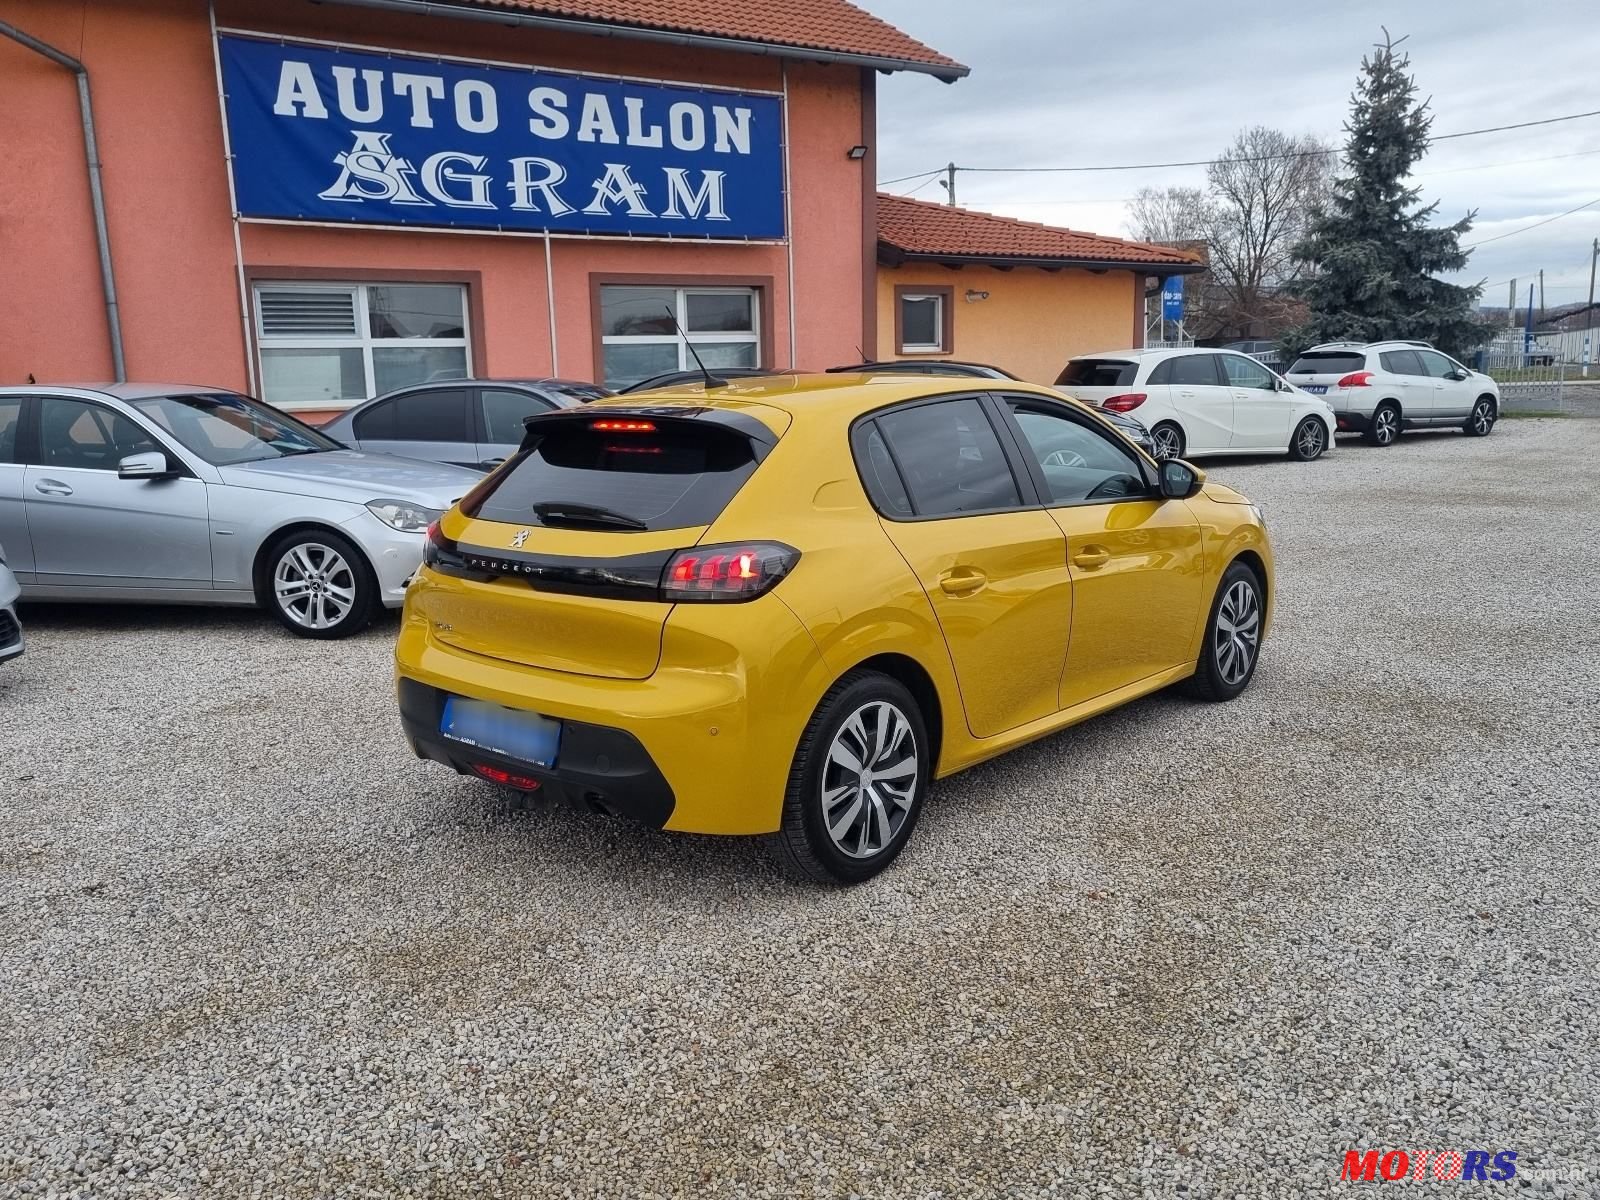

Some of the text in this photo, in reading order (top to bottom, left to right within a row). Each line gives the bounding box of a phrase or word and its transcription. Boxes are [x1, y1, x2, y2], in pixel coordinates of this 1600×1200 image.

[273, 60, 753, 155] AUTO SALON
[471, 559, 544, 575] PEUGEOT
